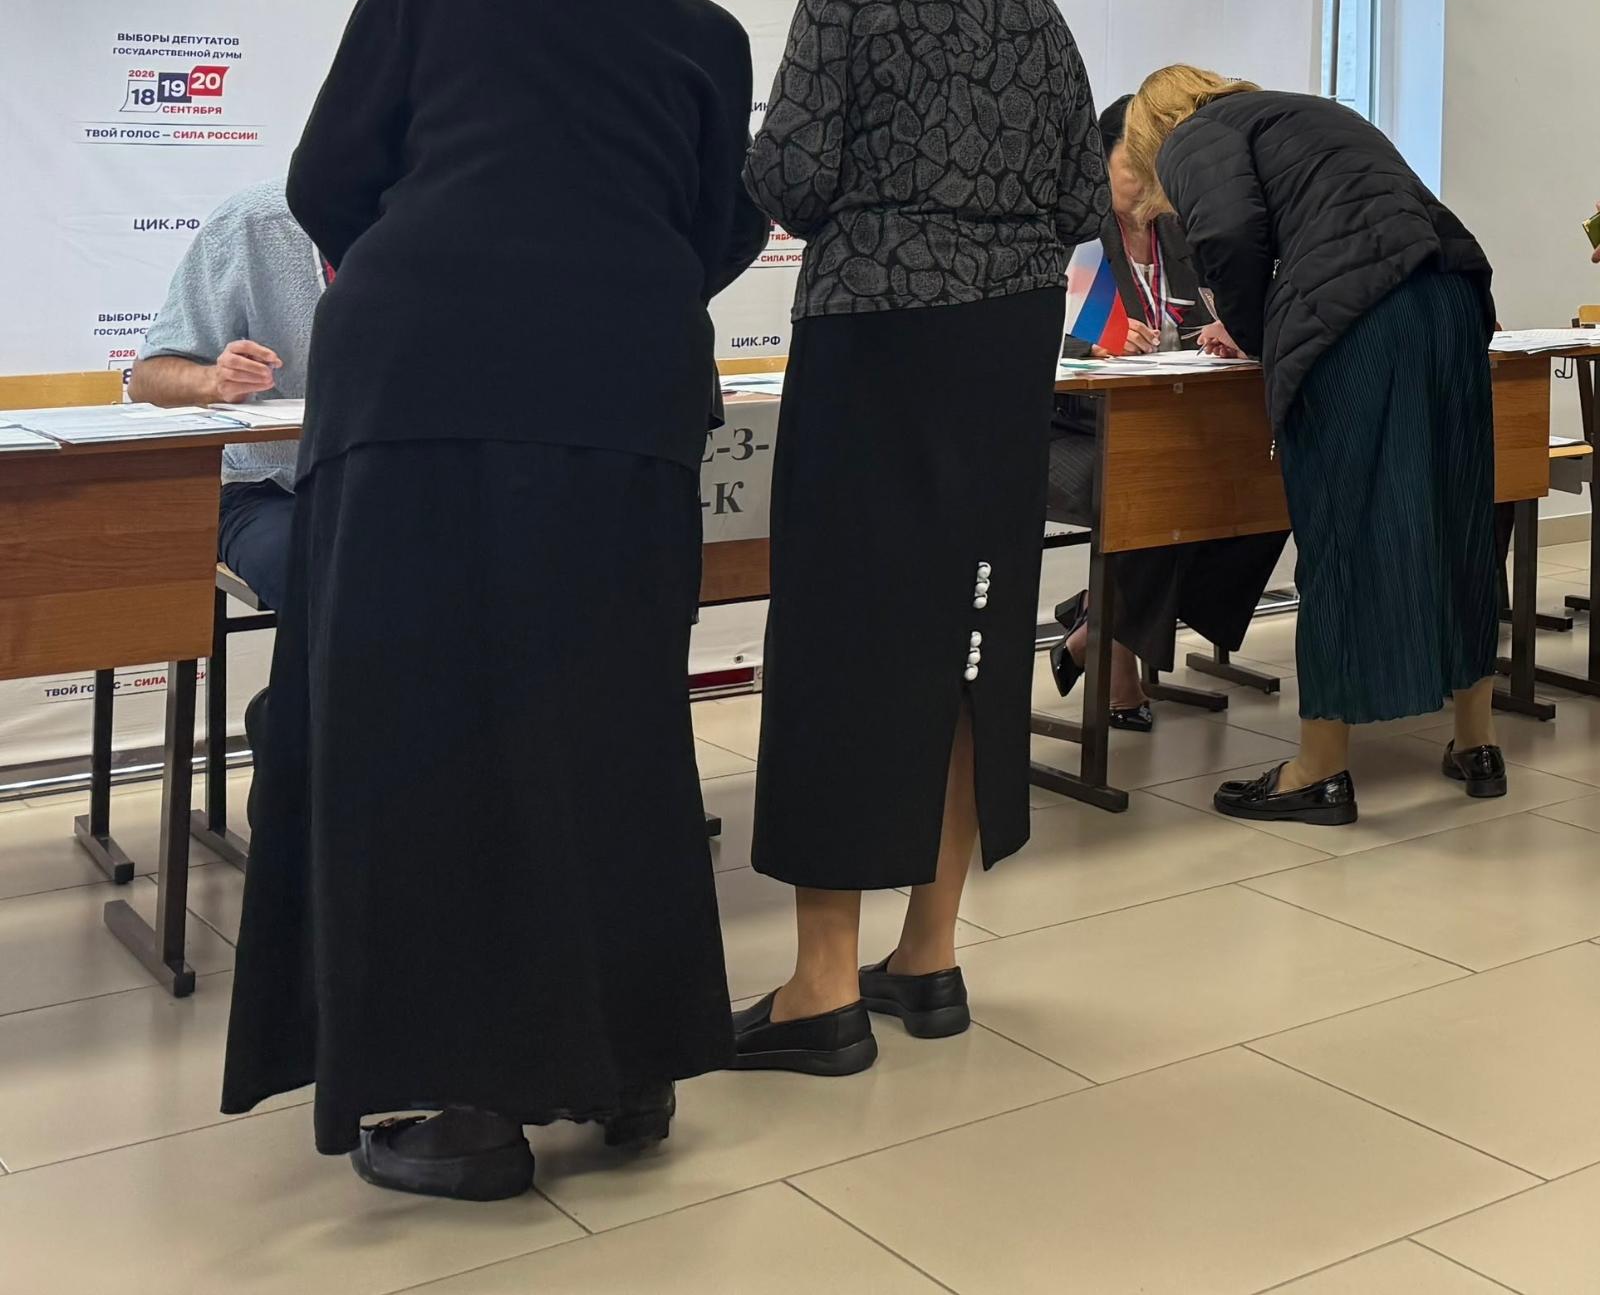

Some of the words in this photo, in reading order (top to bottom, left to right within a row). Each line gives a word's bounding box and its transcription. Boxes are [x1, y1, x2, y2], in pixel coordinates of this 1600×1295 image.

[117, 33, 170, 43] ВЫБОРЫ
[172, 35, 240, 46] ДЕПУТАТОВ
[113, 46, 211, 58] ГОСУДАРСТВЕННОЙ
[213, 51, 242, 59] ДУМЫ
[128, 69, 155, 78] 2026
[131, 88, 155, 105] 18
[161, 79, 186, 97] 19
[191, 72, 221, 90] 20
[162, 105, 223, 115] СЕНТЯБРЯ
[85, 127, 118, 139] ТВОЙ
[120, 129, 160, 139] ГОЛОС
[173, 130, 205, 140] СИЛА
[207, 131, 258, 141] РОССИИ!
[133, 218, 201, 232] ЦИК.РФ
[760, 254, 785, 263] СИЛА
[98, 313, 151, 322] ВЫБОРЫ
[94, 327, 149, 336] ГОСУДАРС
[731, 336, 781, 348] ЦИК.РФ
[109, 349, 136, 358] 2026
[44, 685, 78, 698] ТВОЙ
[134, 676, 166, 688] СИЛА
